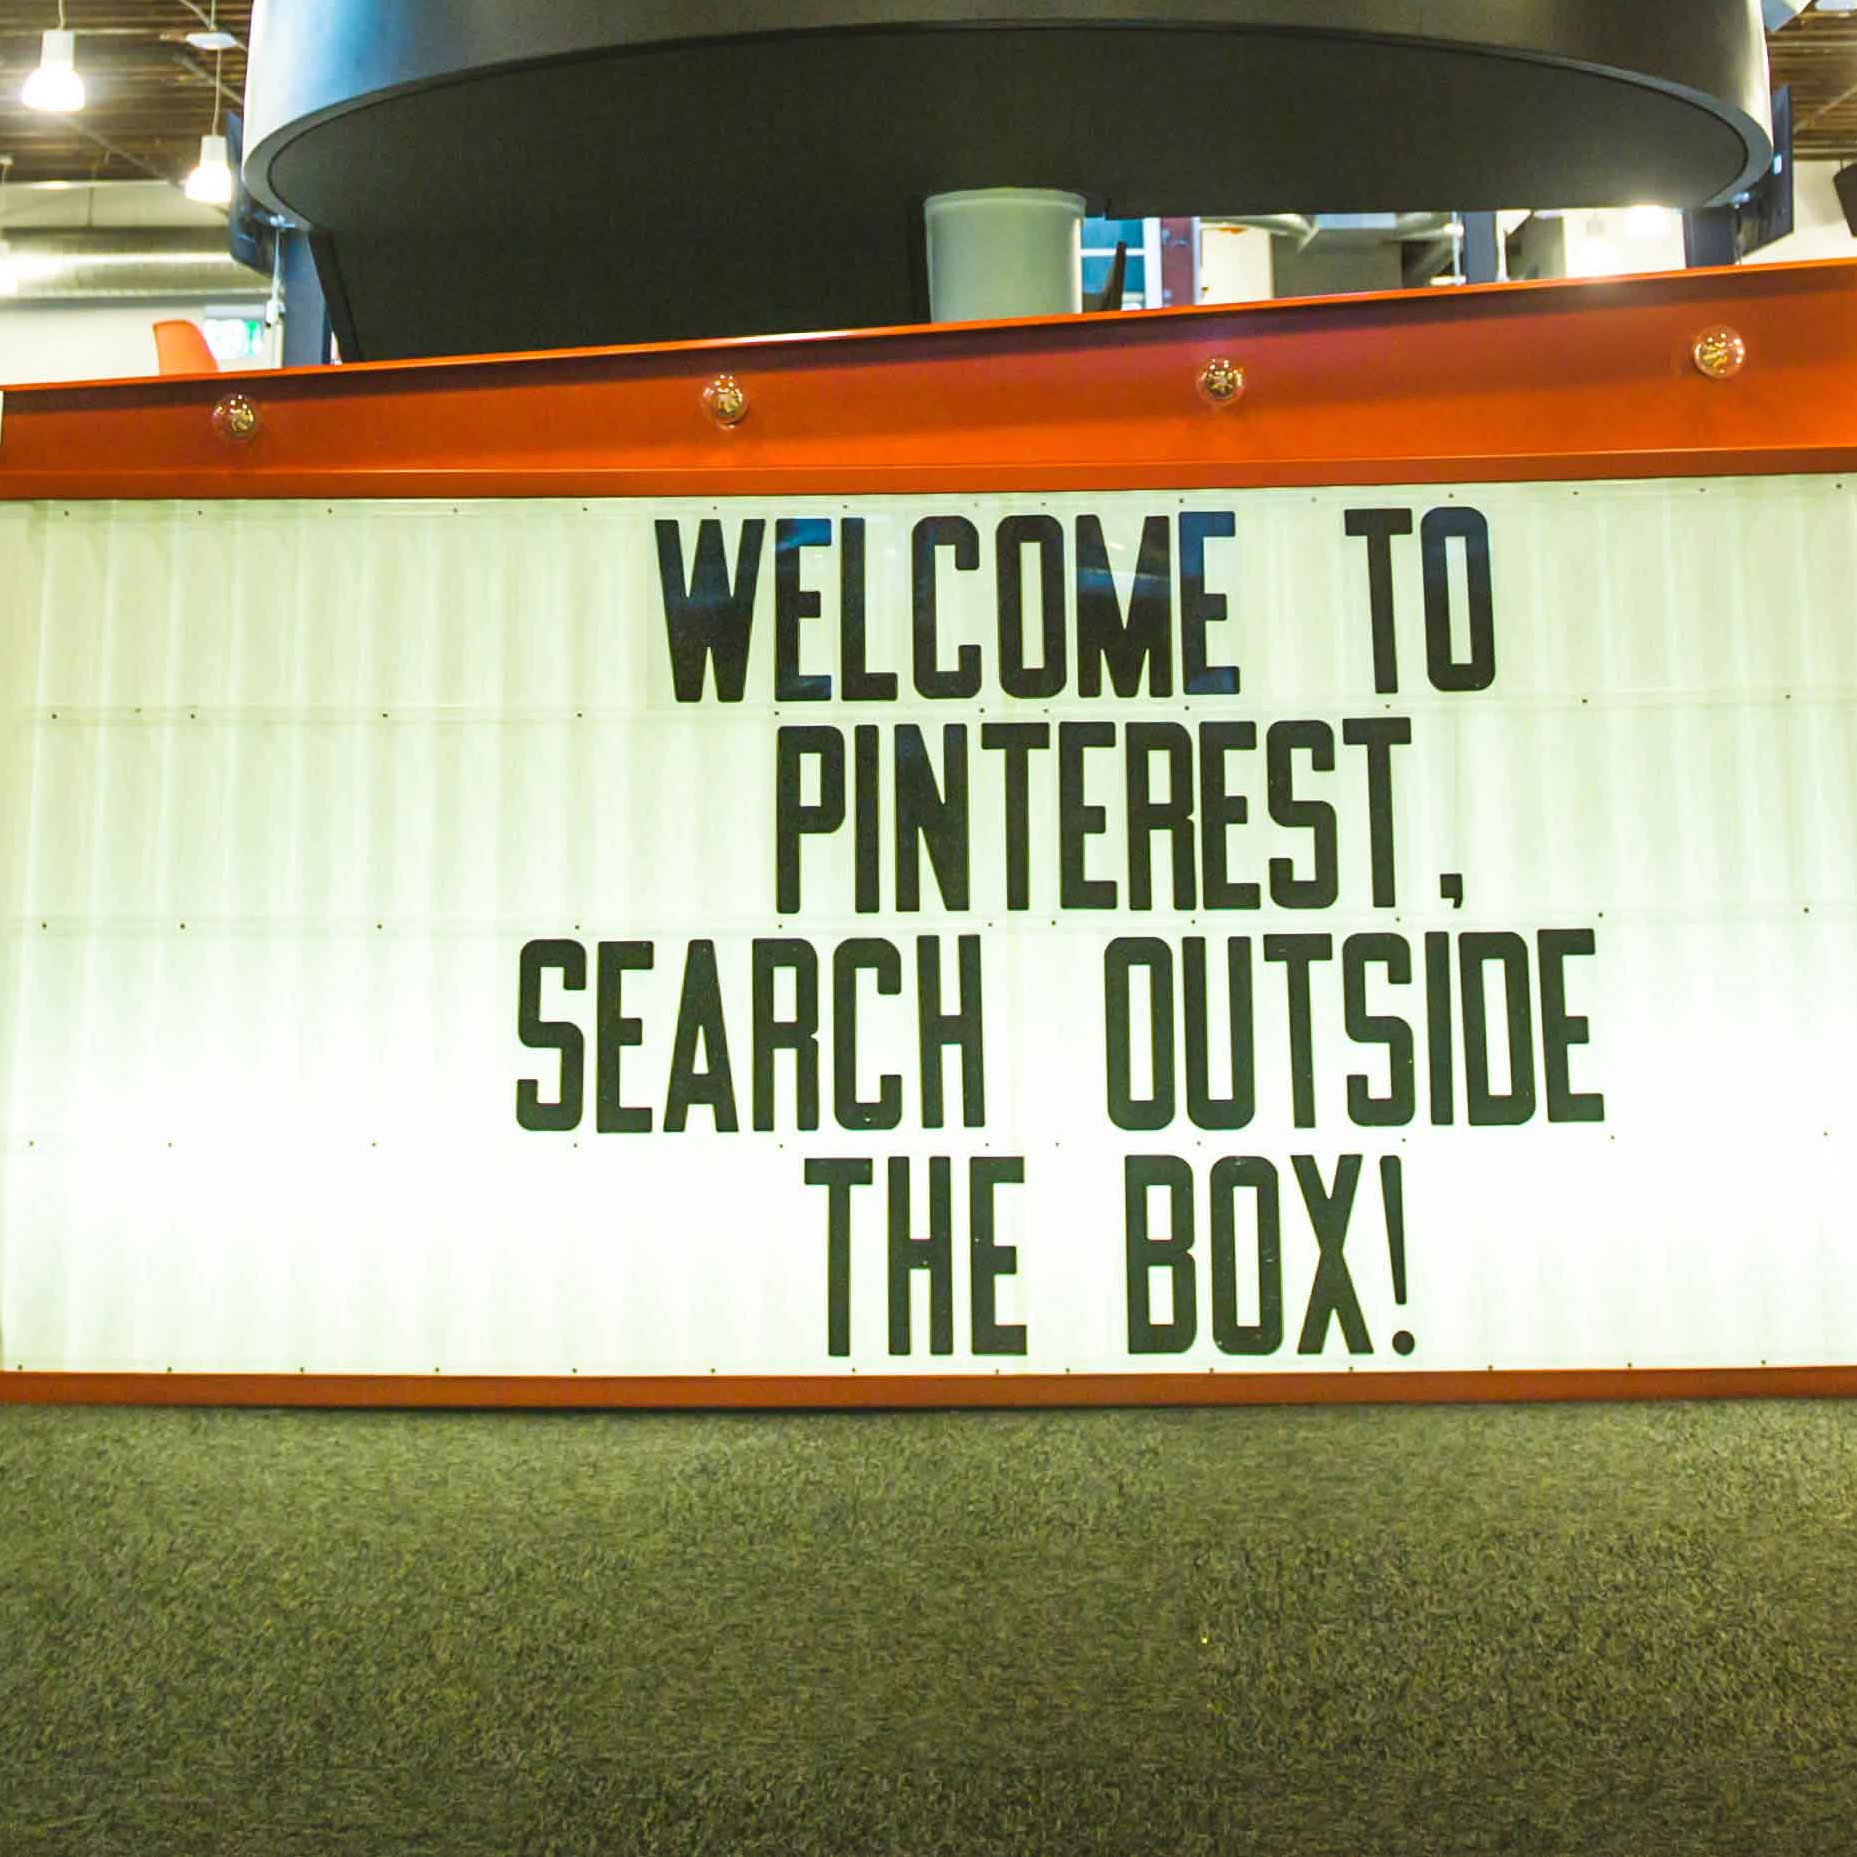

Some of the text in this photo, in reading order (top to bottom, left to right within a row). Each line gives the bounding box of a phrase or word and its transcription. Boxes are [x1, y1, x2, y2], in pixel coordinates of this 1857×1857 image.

[653, 506, 1496, 703] WELCOME TO
[776, 716, 1464, 914] PINTEREST,
[516, 928, 1605, 1133] SEARCH OUTSIDE
[804, 1154, 1415, 1356] THE BOX!
